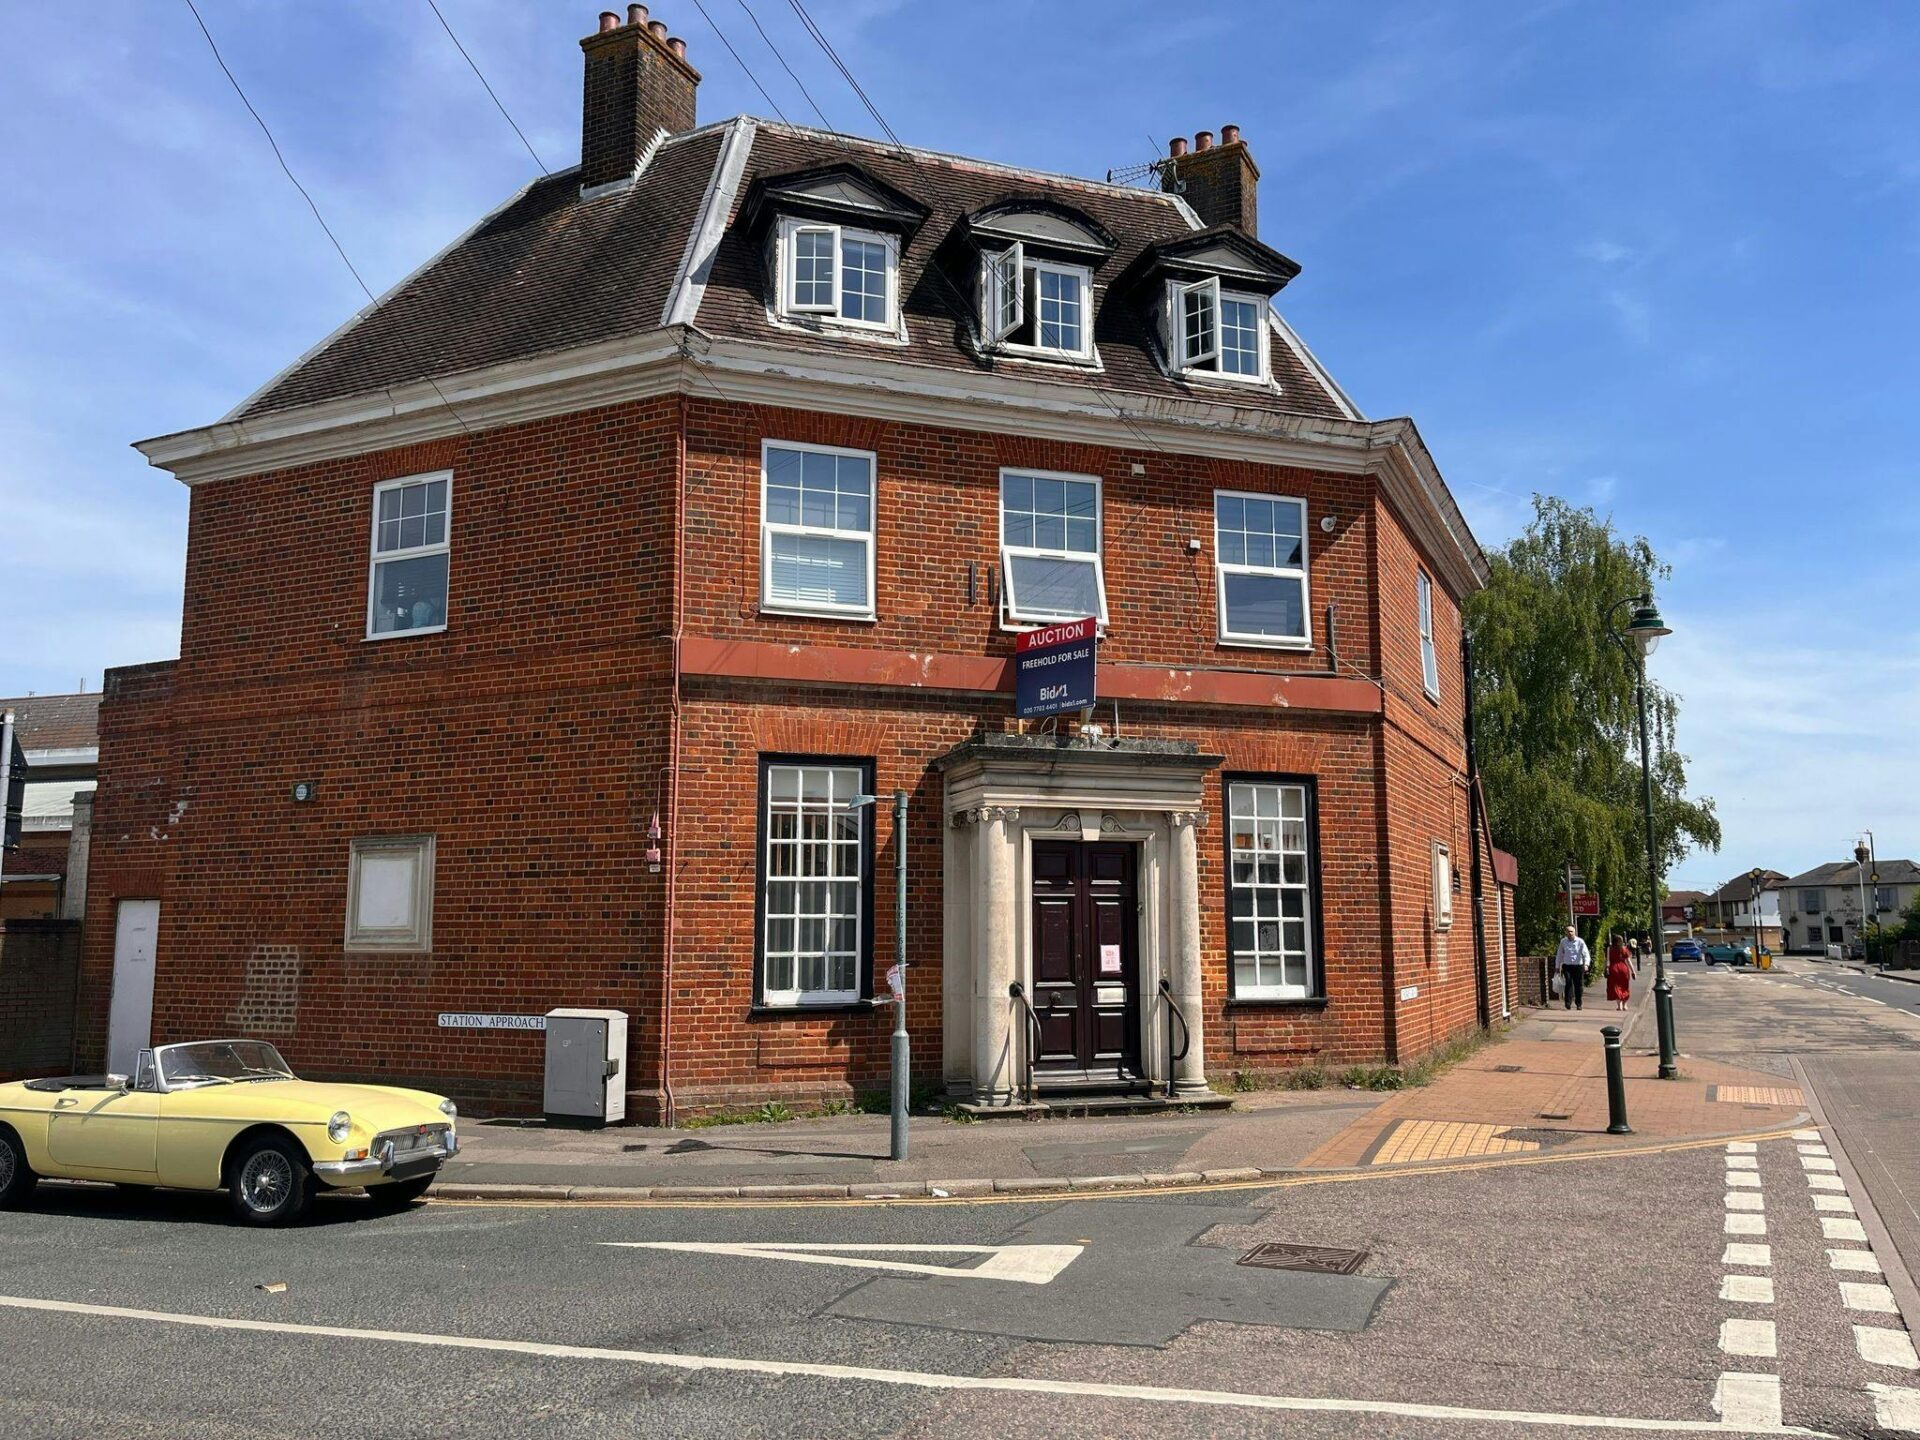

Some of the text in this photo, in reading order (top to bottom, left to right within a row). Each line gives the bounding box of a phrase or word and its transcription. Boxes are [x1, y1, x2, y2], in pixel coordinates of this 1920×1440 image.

[1028, 623, 1084, 648] AUCTION
[1022, 648, 1090, 670] FREEHOLD FOR SALE
[440, 1015, 544, 1028] STATION APPROACH
